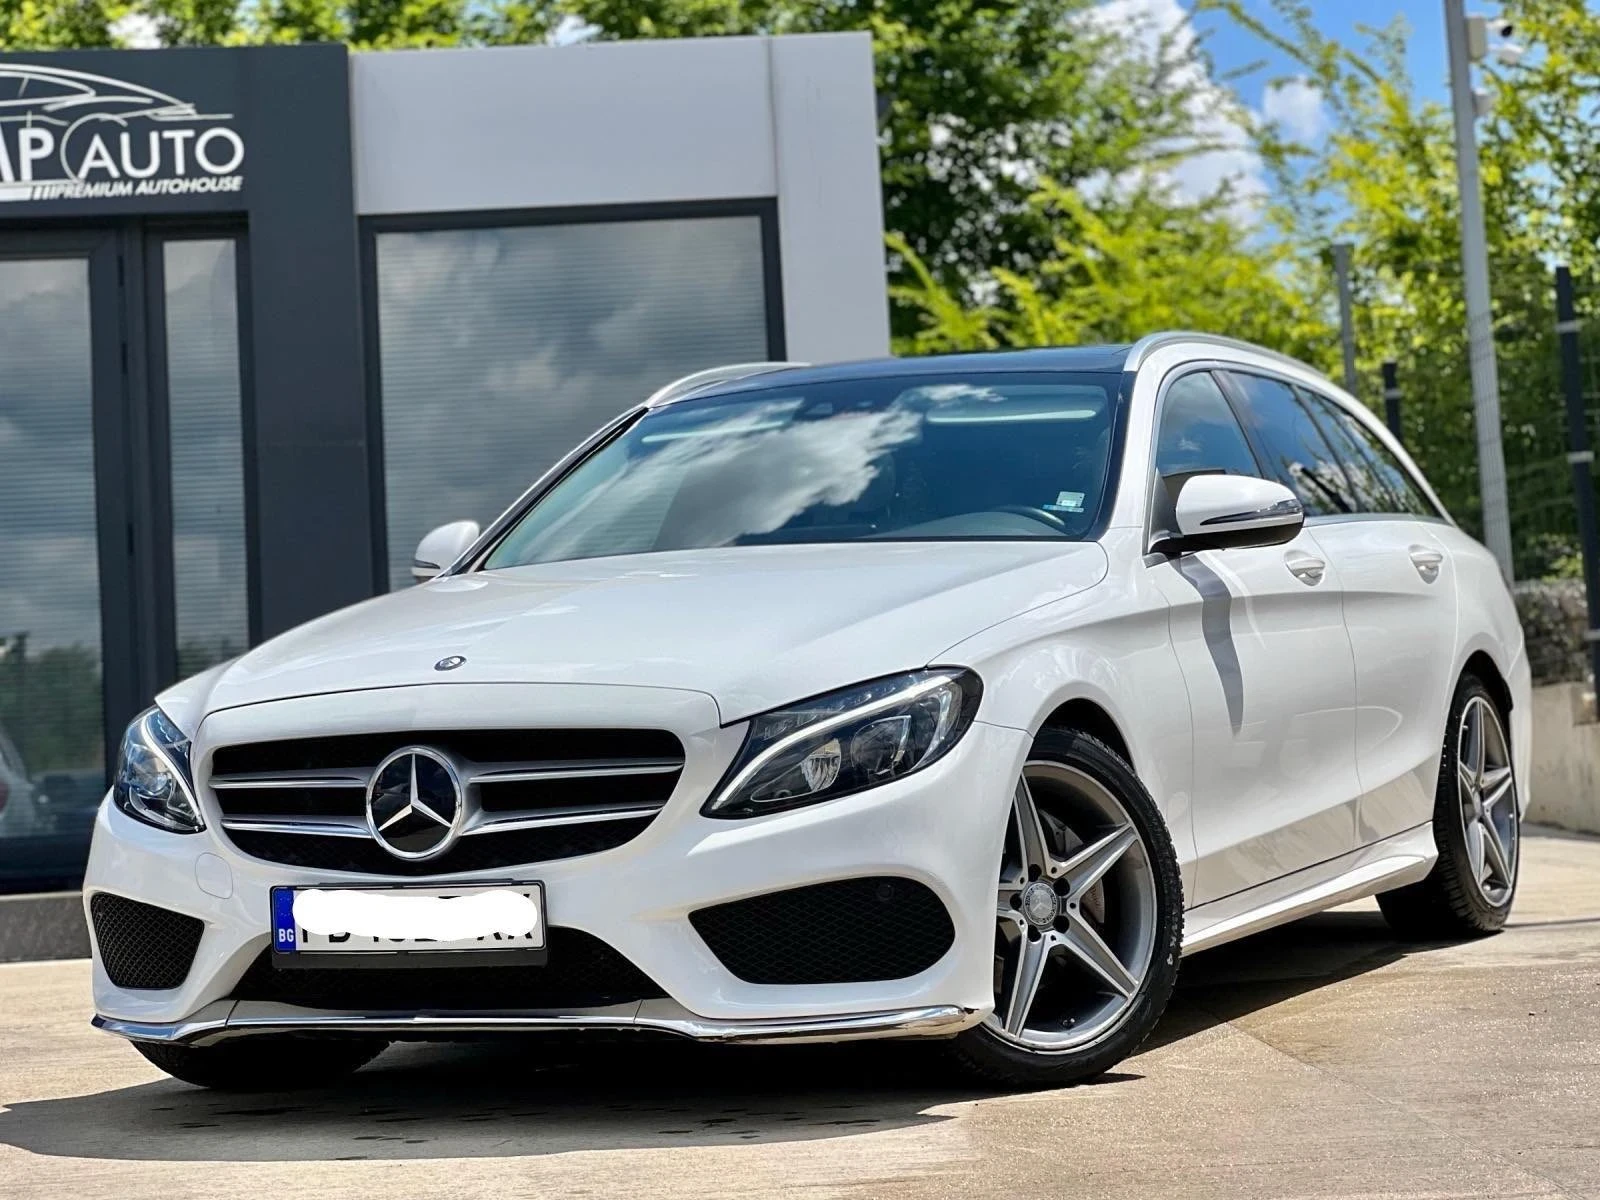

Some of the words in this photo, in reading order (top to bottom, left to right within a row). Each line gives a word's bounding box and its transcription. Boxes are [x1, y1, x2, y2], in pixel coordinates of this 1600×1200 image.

[78, 127, 245, 179] AUTO
[55, 180, 133, 199] PREMIUM
[135, 176, 243, 195] AUTOHOUSE
[278, 928, 294, 943] BG
